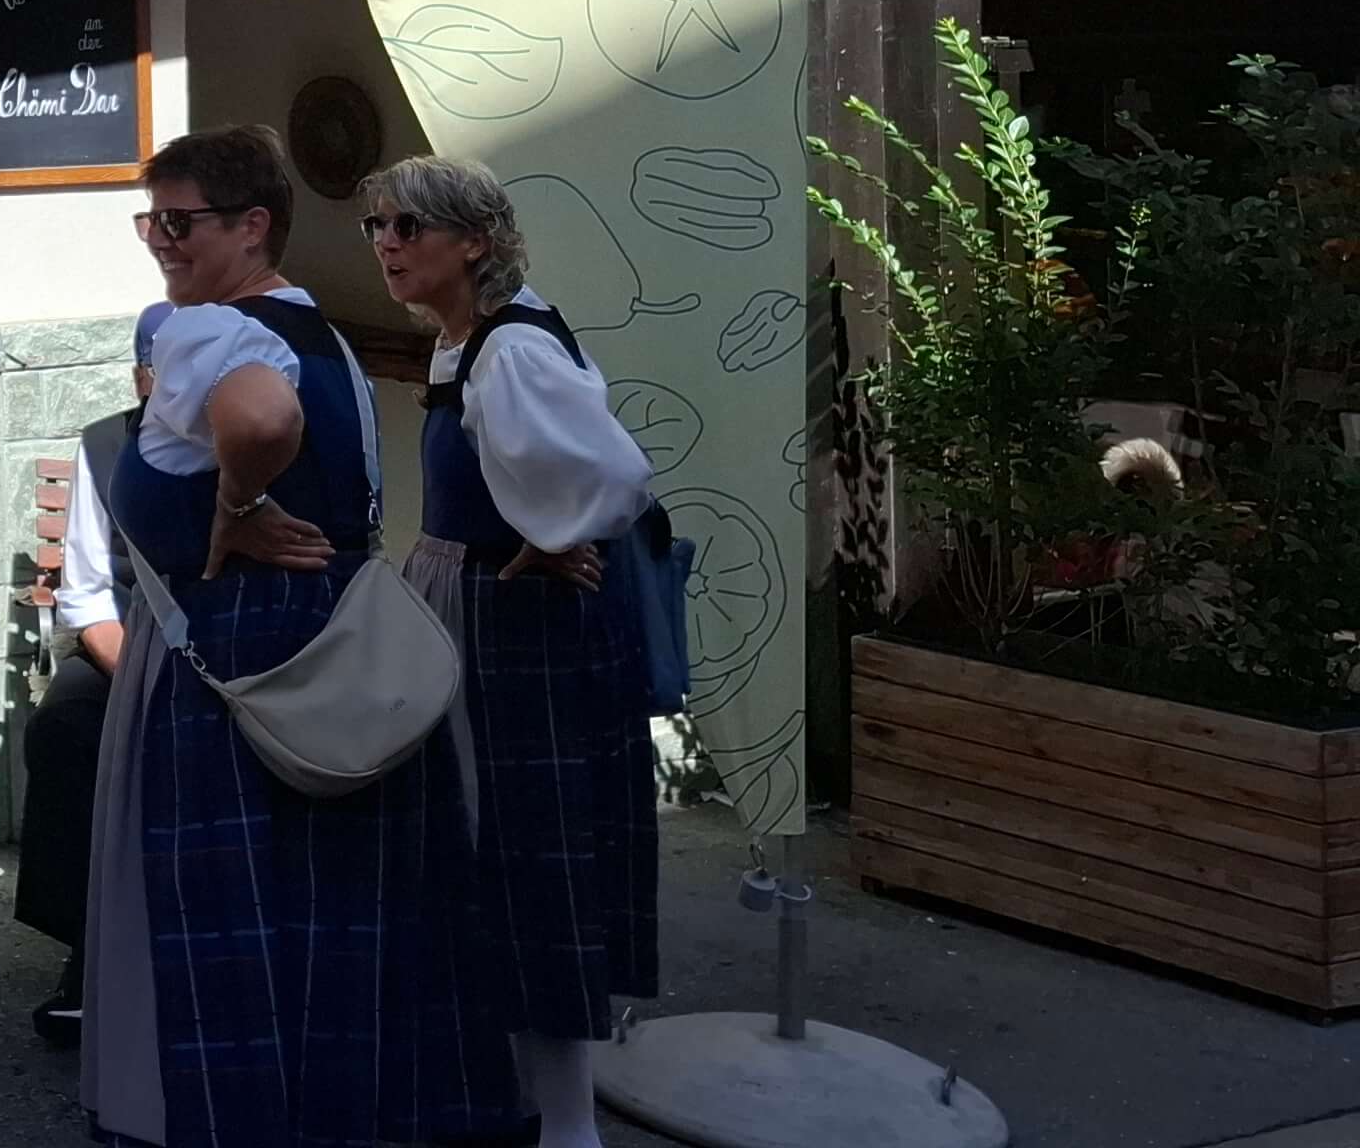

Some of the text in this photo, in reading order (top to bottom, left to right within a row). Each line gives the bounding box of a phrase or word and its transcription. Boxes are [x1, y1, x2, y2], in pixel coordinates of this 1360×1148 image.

[83, 18, 104, 32] an
[77, 36, 104, 52] der
[69, 62, 120, 116] Bar
